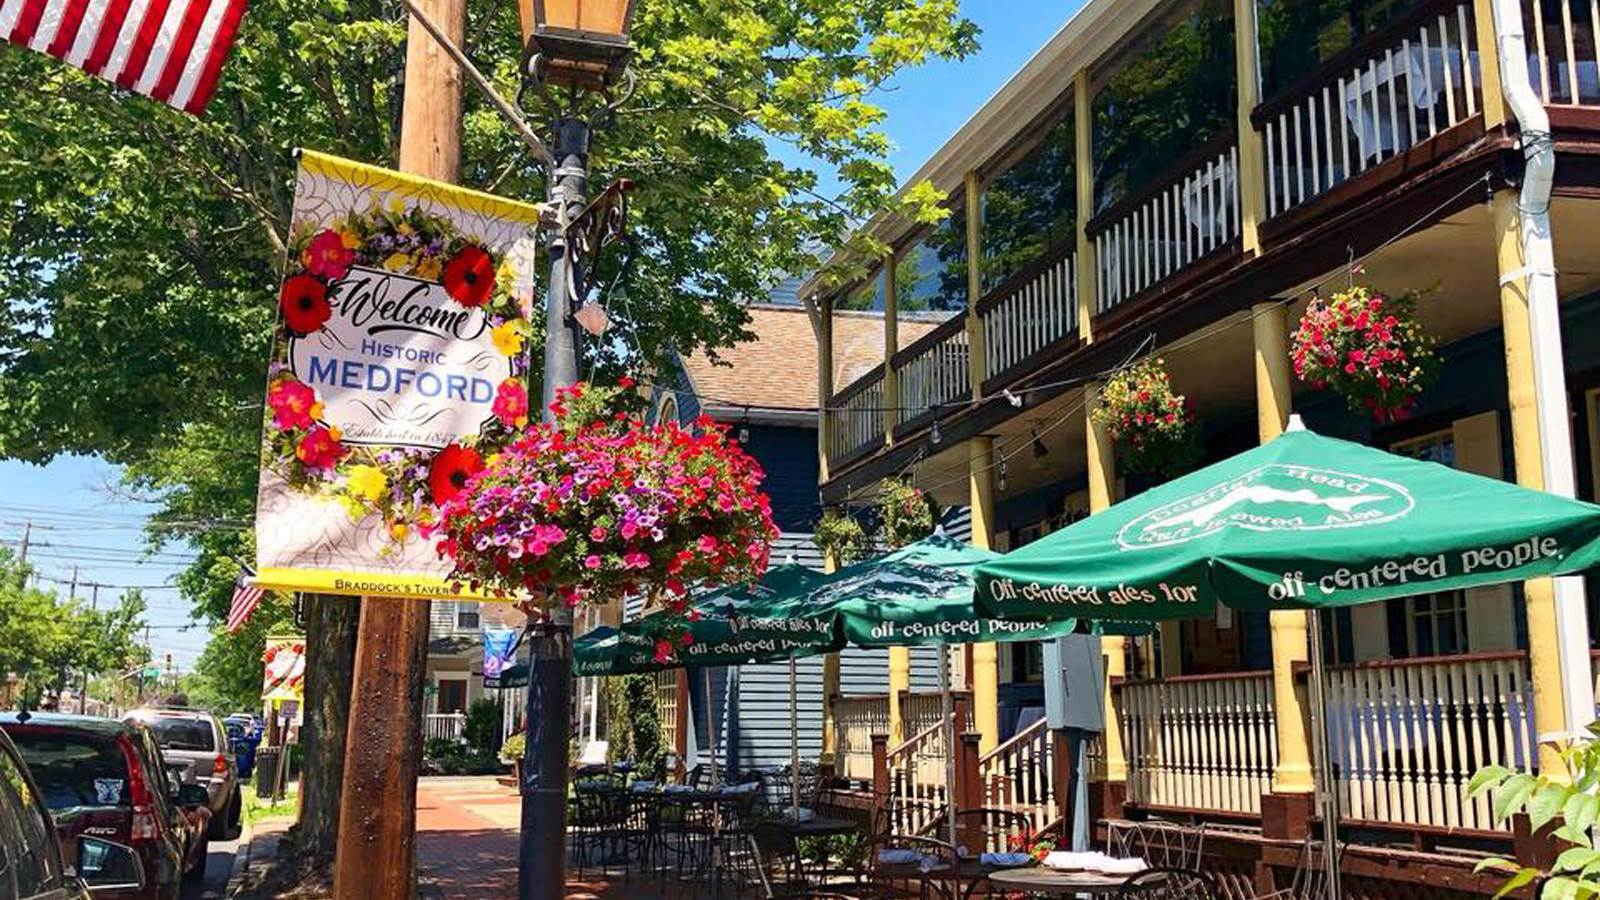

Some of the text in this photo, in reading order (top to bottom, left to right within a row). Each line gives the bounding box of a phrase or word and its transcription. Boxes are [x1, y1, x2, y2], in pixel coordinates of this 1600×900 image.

[330, 276, 487, 340] Welcome
[308, 355, 494, 405] MEDFORD
[1286, 469, 1370, 493] Head
[989, 578, 1103, 605] Off-centered
[1108, 582, 1156, 605] ales
[1158, 582, 1199, 603] for
[1268, 553, 1447, 600] off-centered
[871, 619, 980, 639] off-centered
